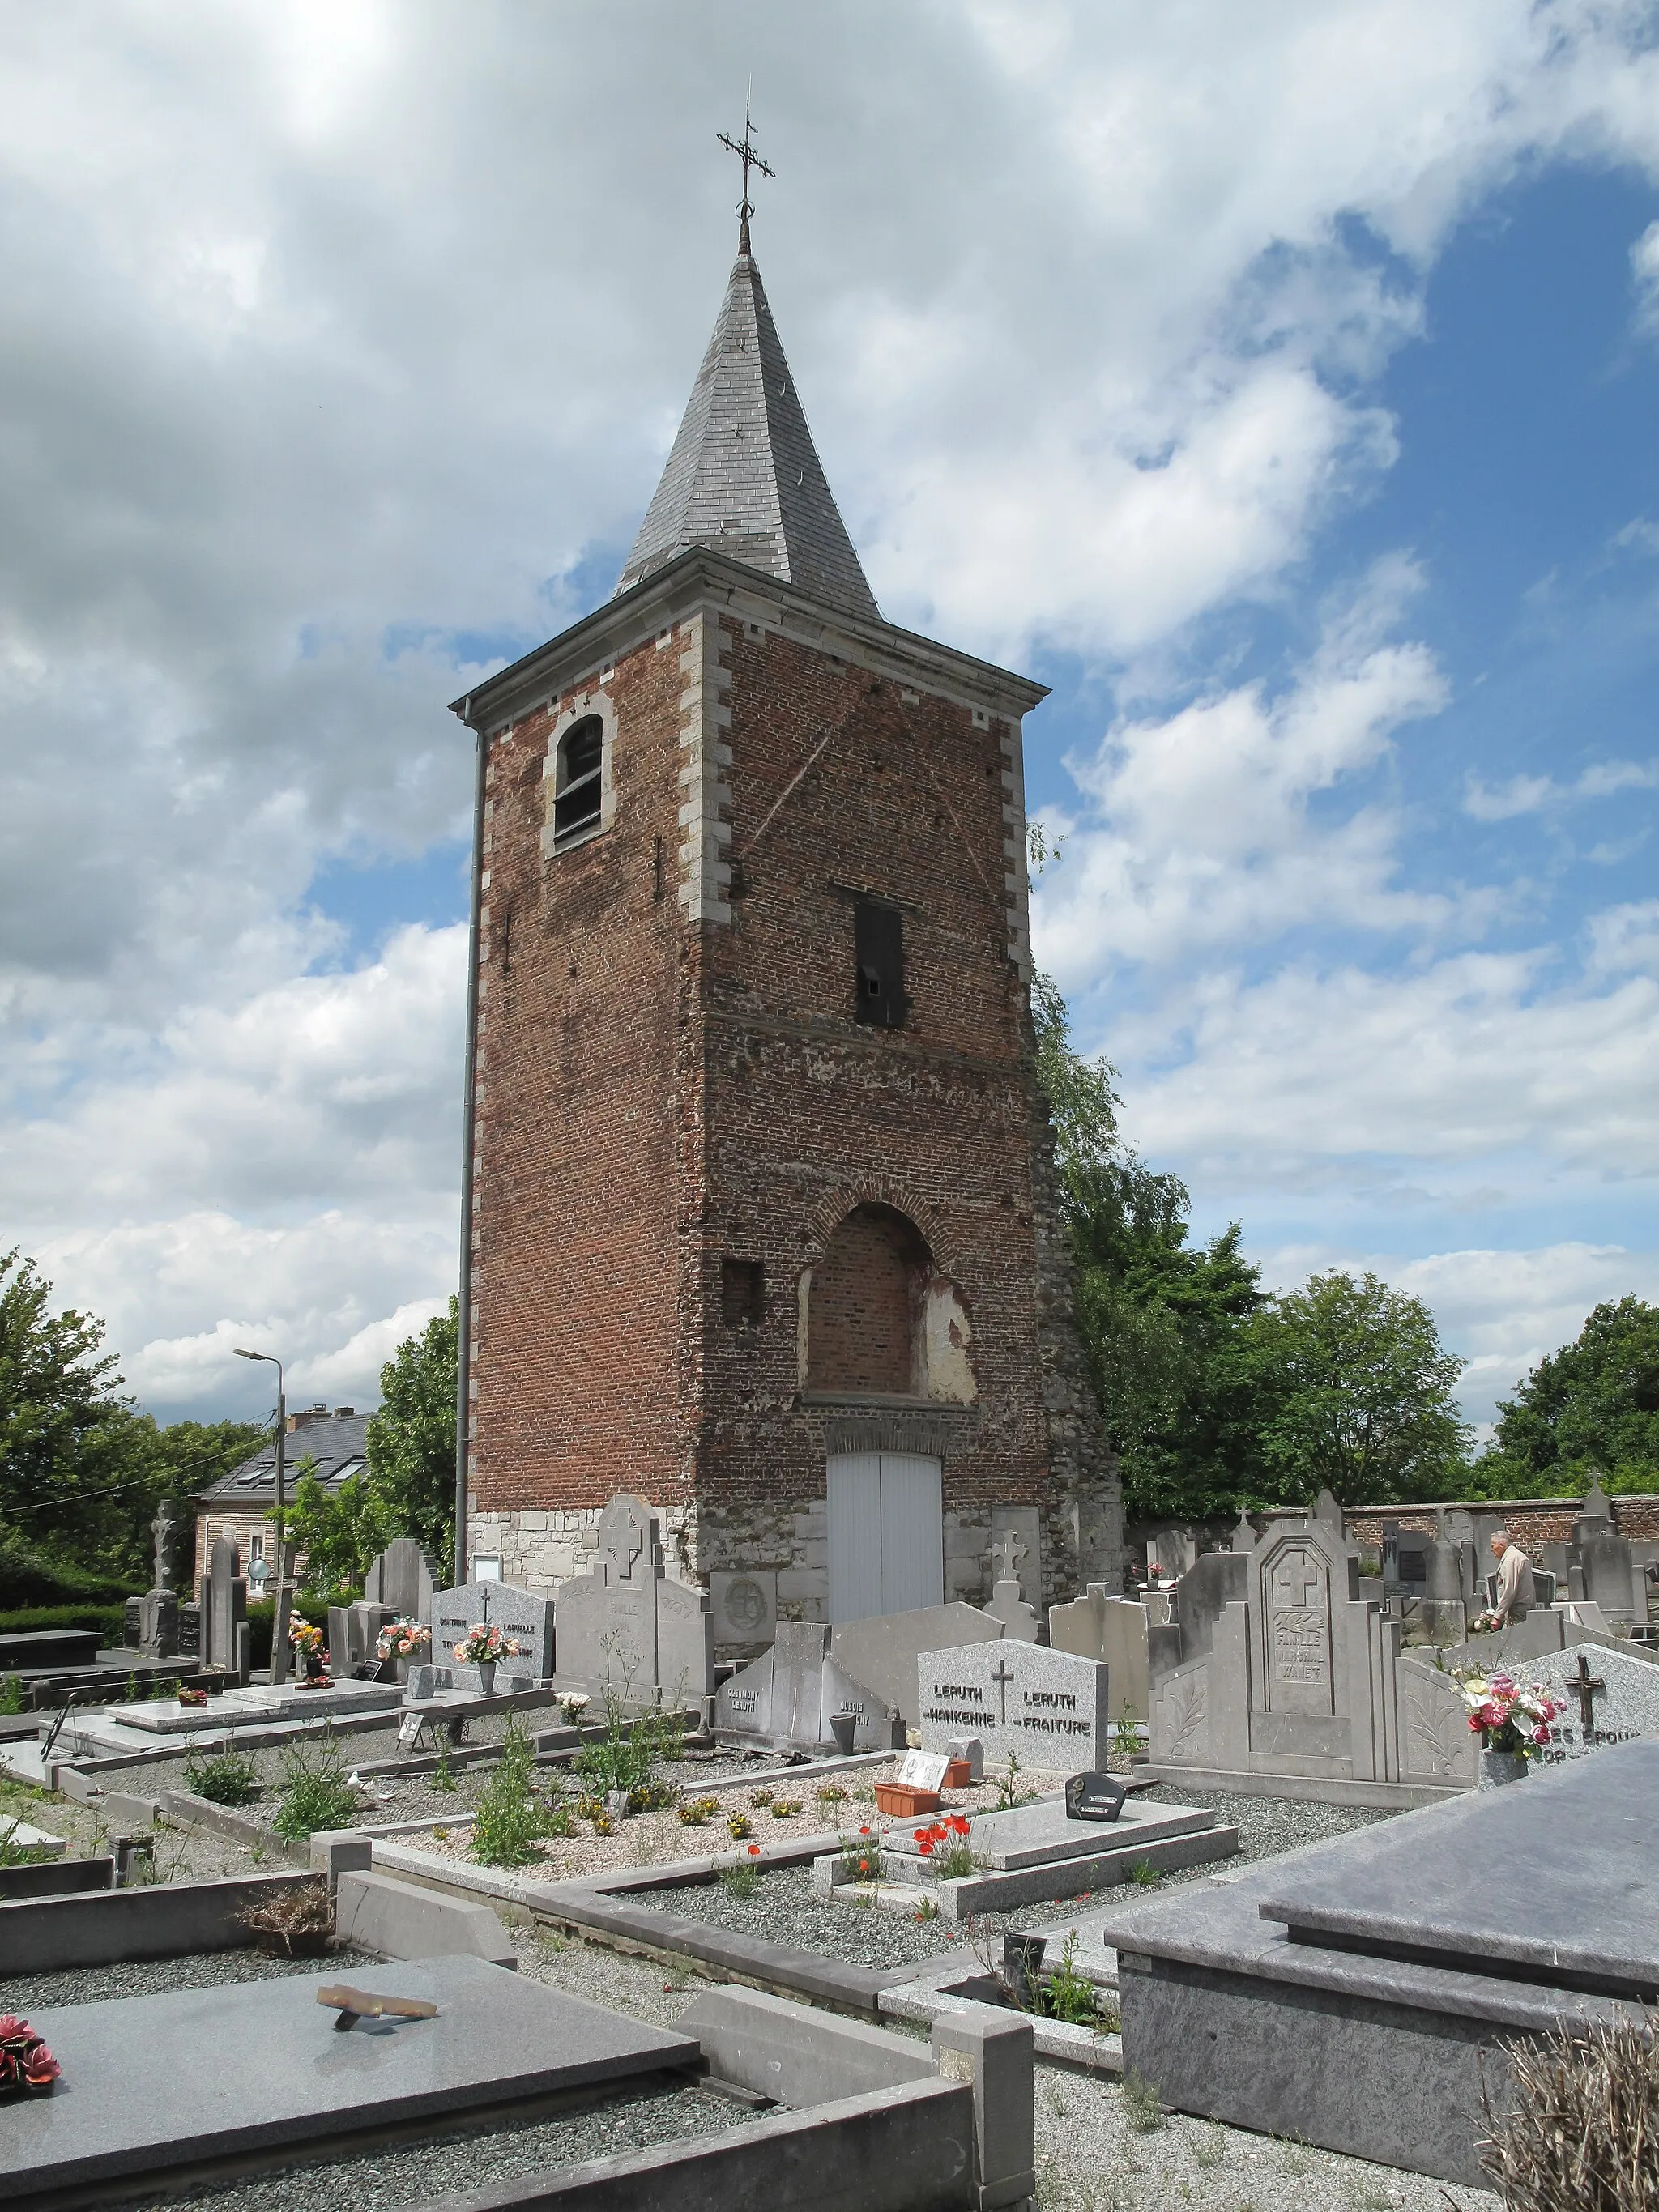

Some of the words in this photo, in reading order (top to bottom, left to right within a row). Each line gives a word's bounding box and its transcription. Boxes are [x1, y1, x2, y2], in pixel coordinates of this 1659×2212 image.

[1277, 1633, 1320, 1646] FAMILLE
[934, 1685, 983, 1703] LERUTH
[1024, 1692, 1076, 1711] LERUTH
[732, 1701, 755, 1713] LERUTH
[840, 1702, 864, 1713] DUBOIS
[1550, 1728, 1573, 1745] ES
